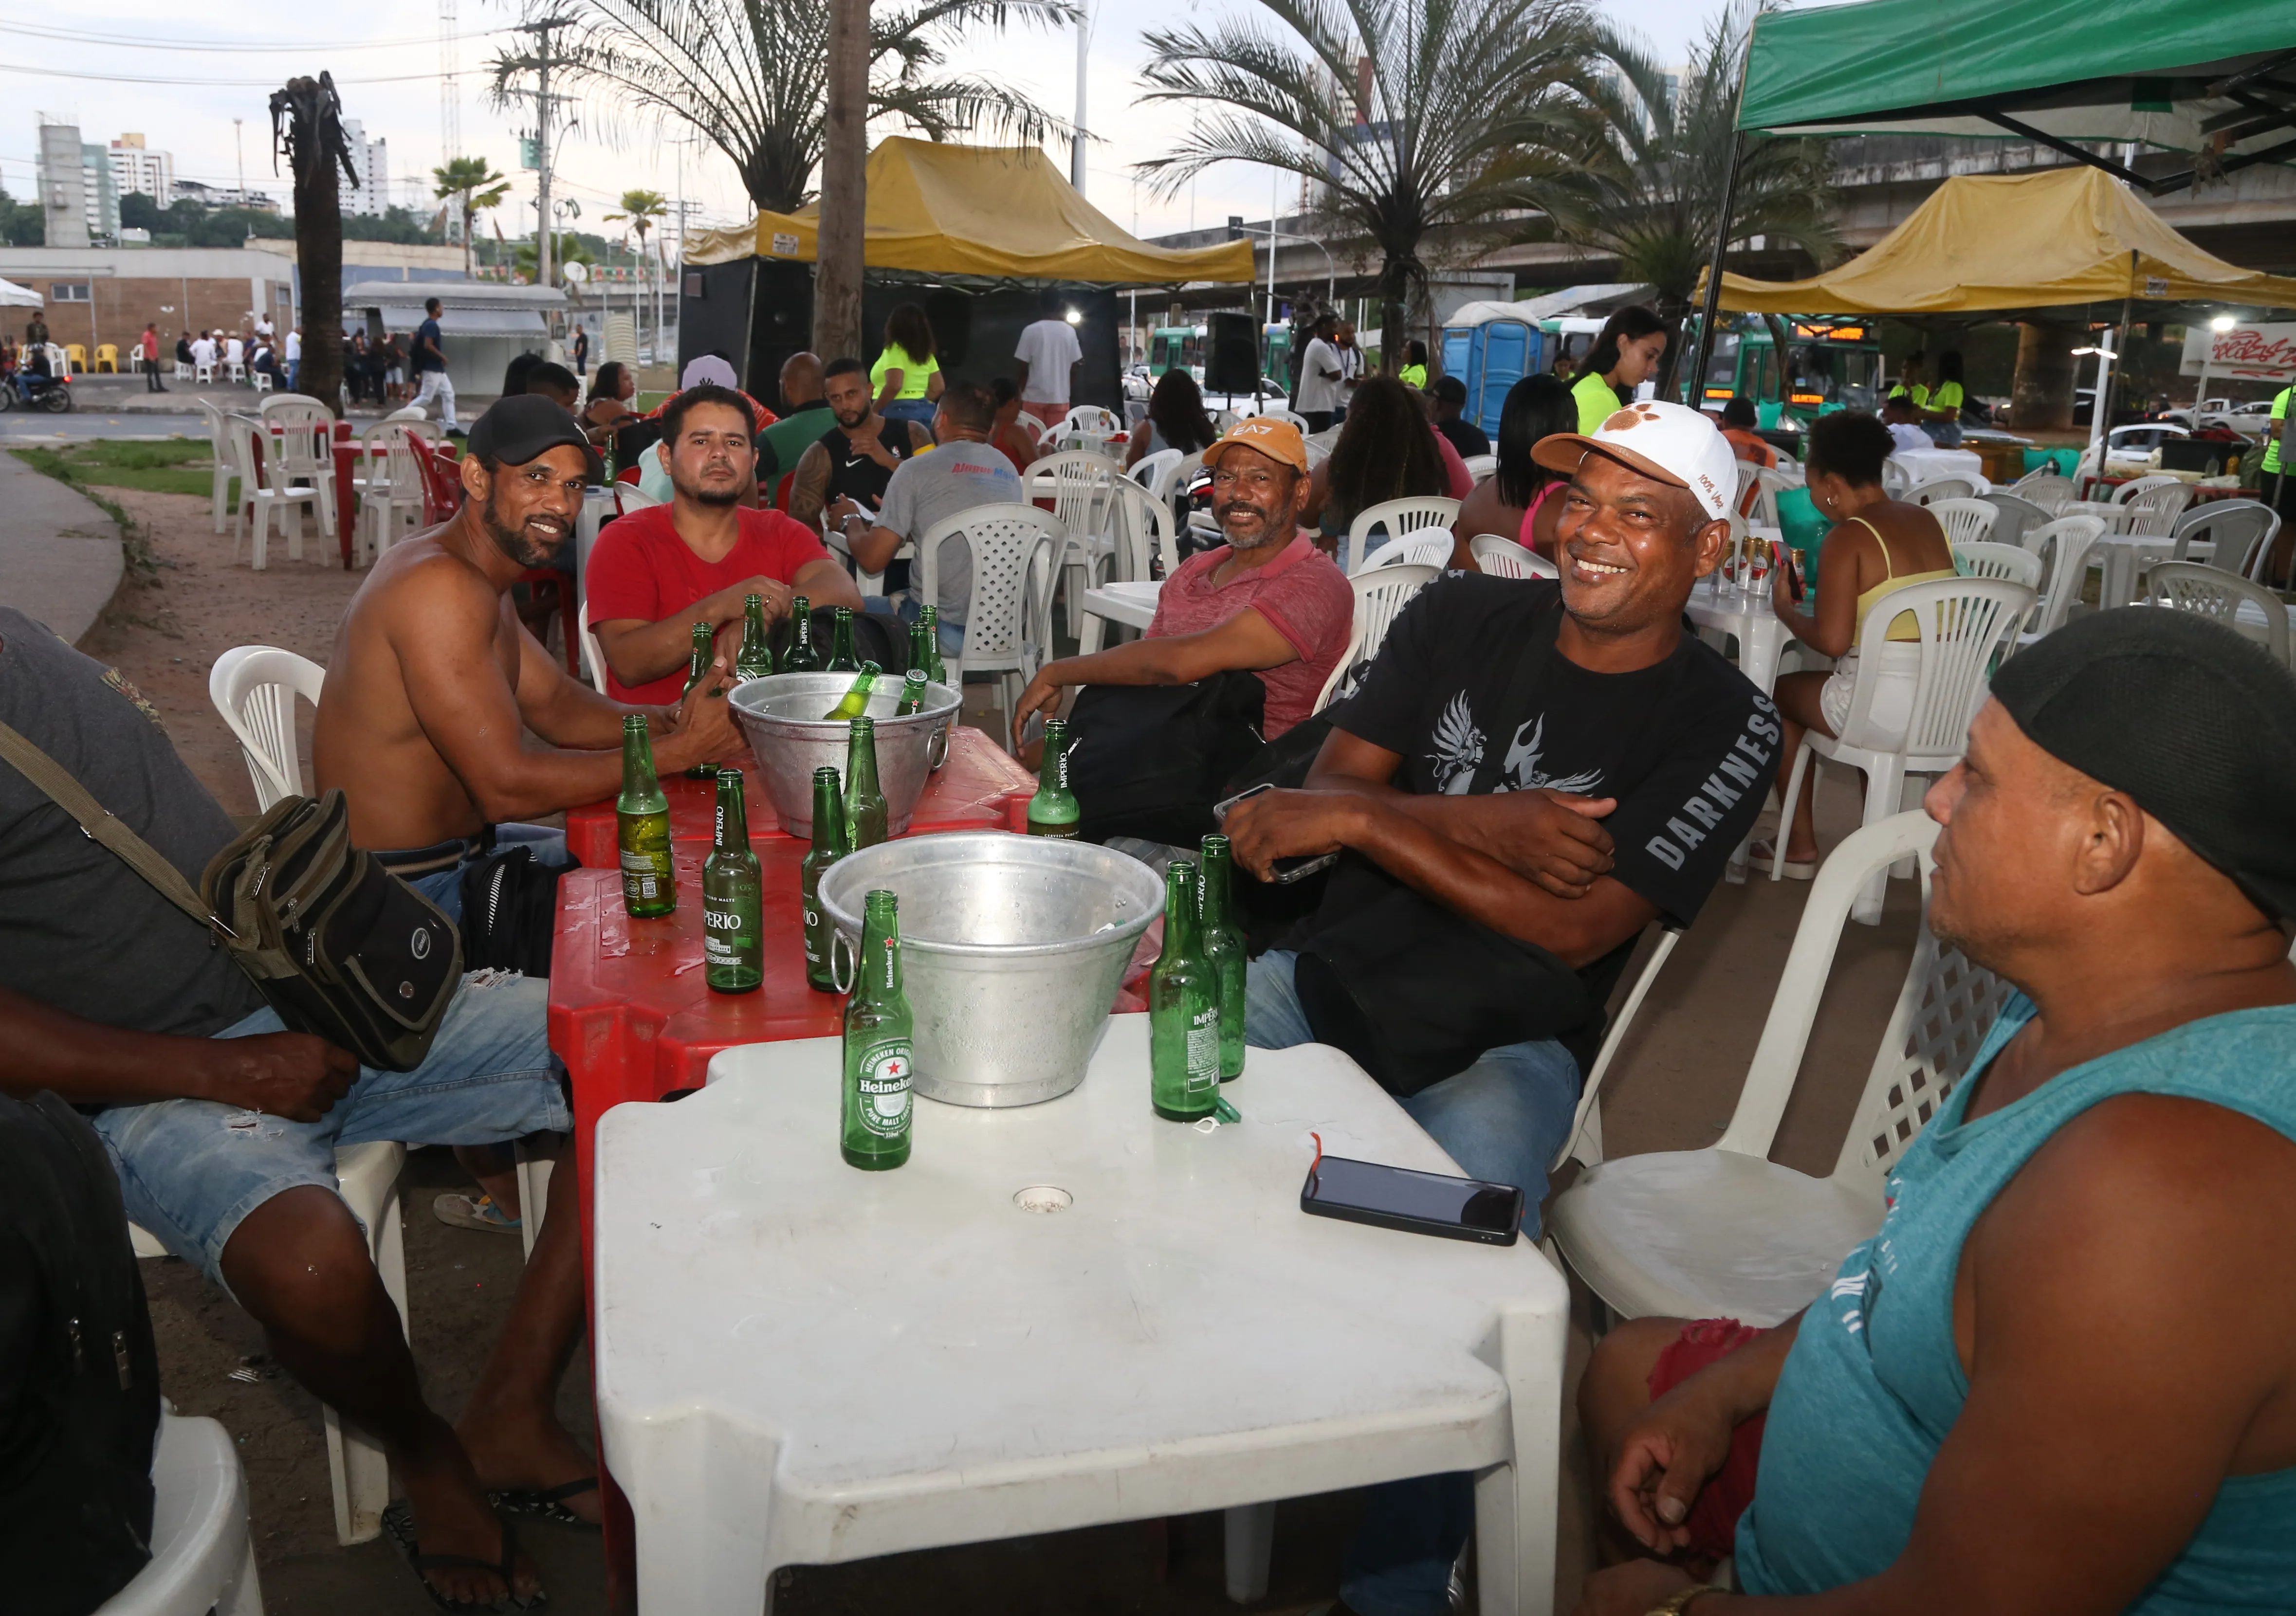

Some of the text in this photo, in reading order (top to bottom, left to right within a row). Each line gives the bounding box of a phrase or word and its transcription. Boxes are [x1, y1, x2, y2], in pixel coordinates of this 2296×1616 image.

[1232, 424, 1273, 436] EA7
[1697, 473, 1715, 493] 100%
[1645, 693, 1781, 872] DARKNESS
[865, 1048, 894, 1073] HEINEKEN
[865, 1107, 882, 1124] PURE
[882, 1117, 900, 1126] MALT
